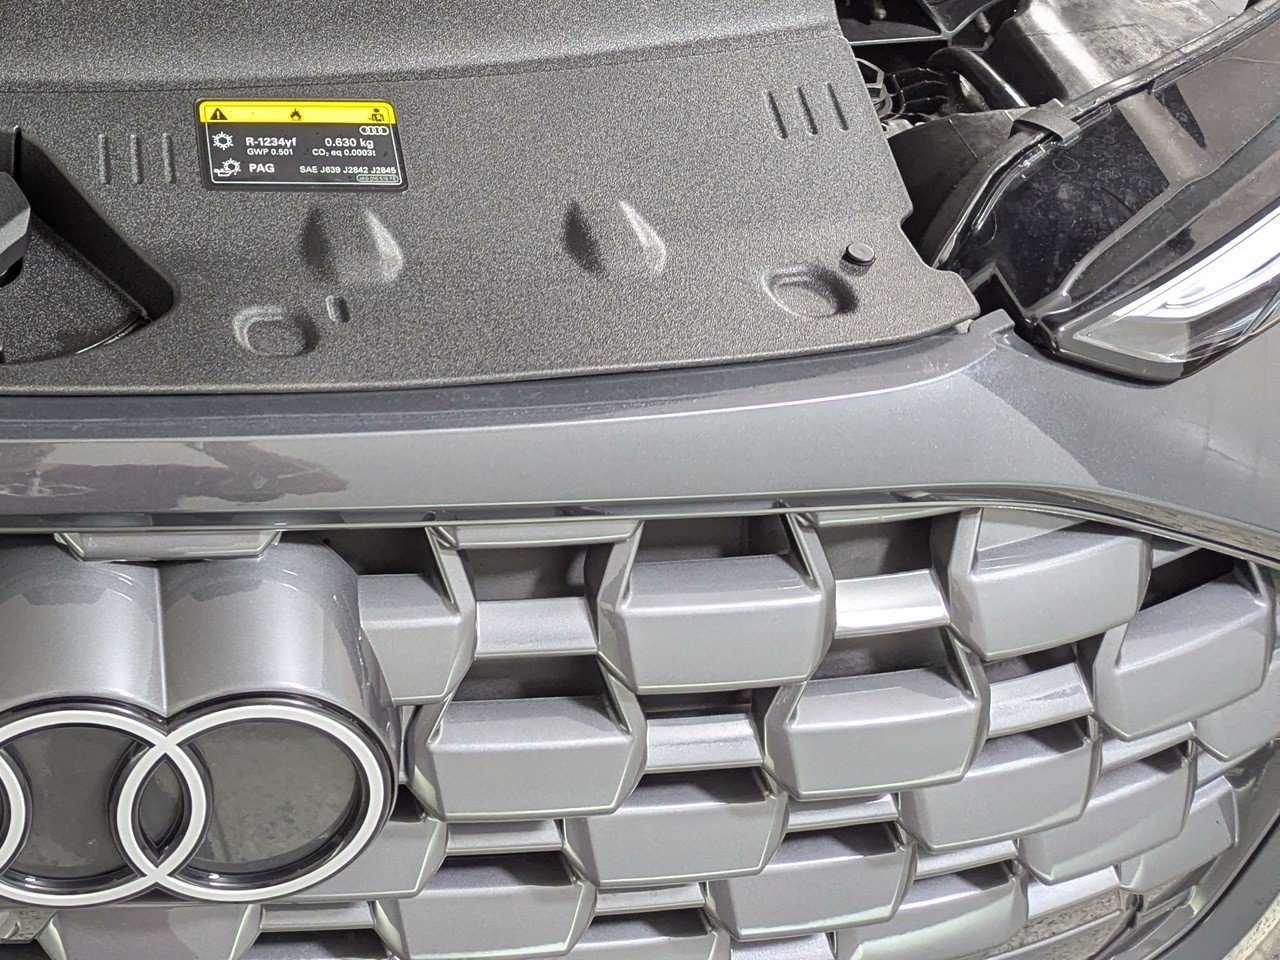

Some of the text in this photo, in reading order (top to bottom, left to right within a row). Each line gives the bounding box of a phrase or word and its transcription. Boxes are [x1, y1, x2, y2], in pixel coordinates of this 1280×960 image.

[246, 137, 297, 148] R-1234yf
[324, 138, 374, 149] 0.630 kg
[248, 164, 275, 172] PAG
[320, 166, 341, 174] J639
